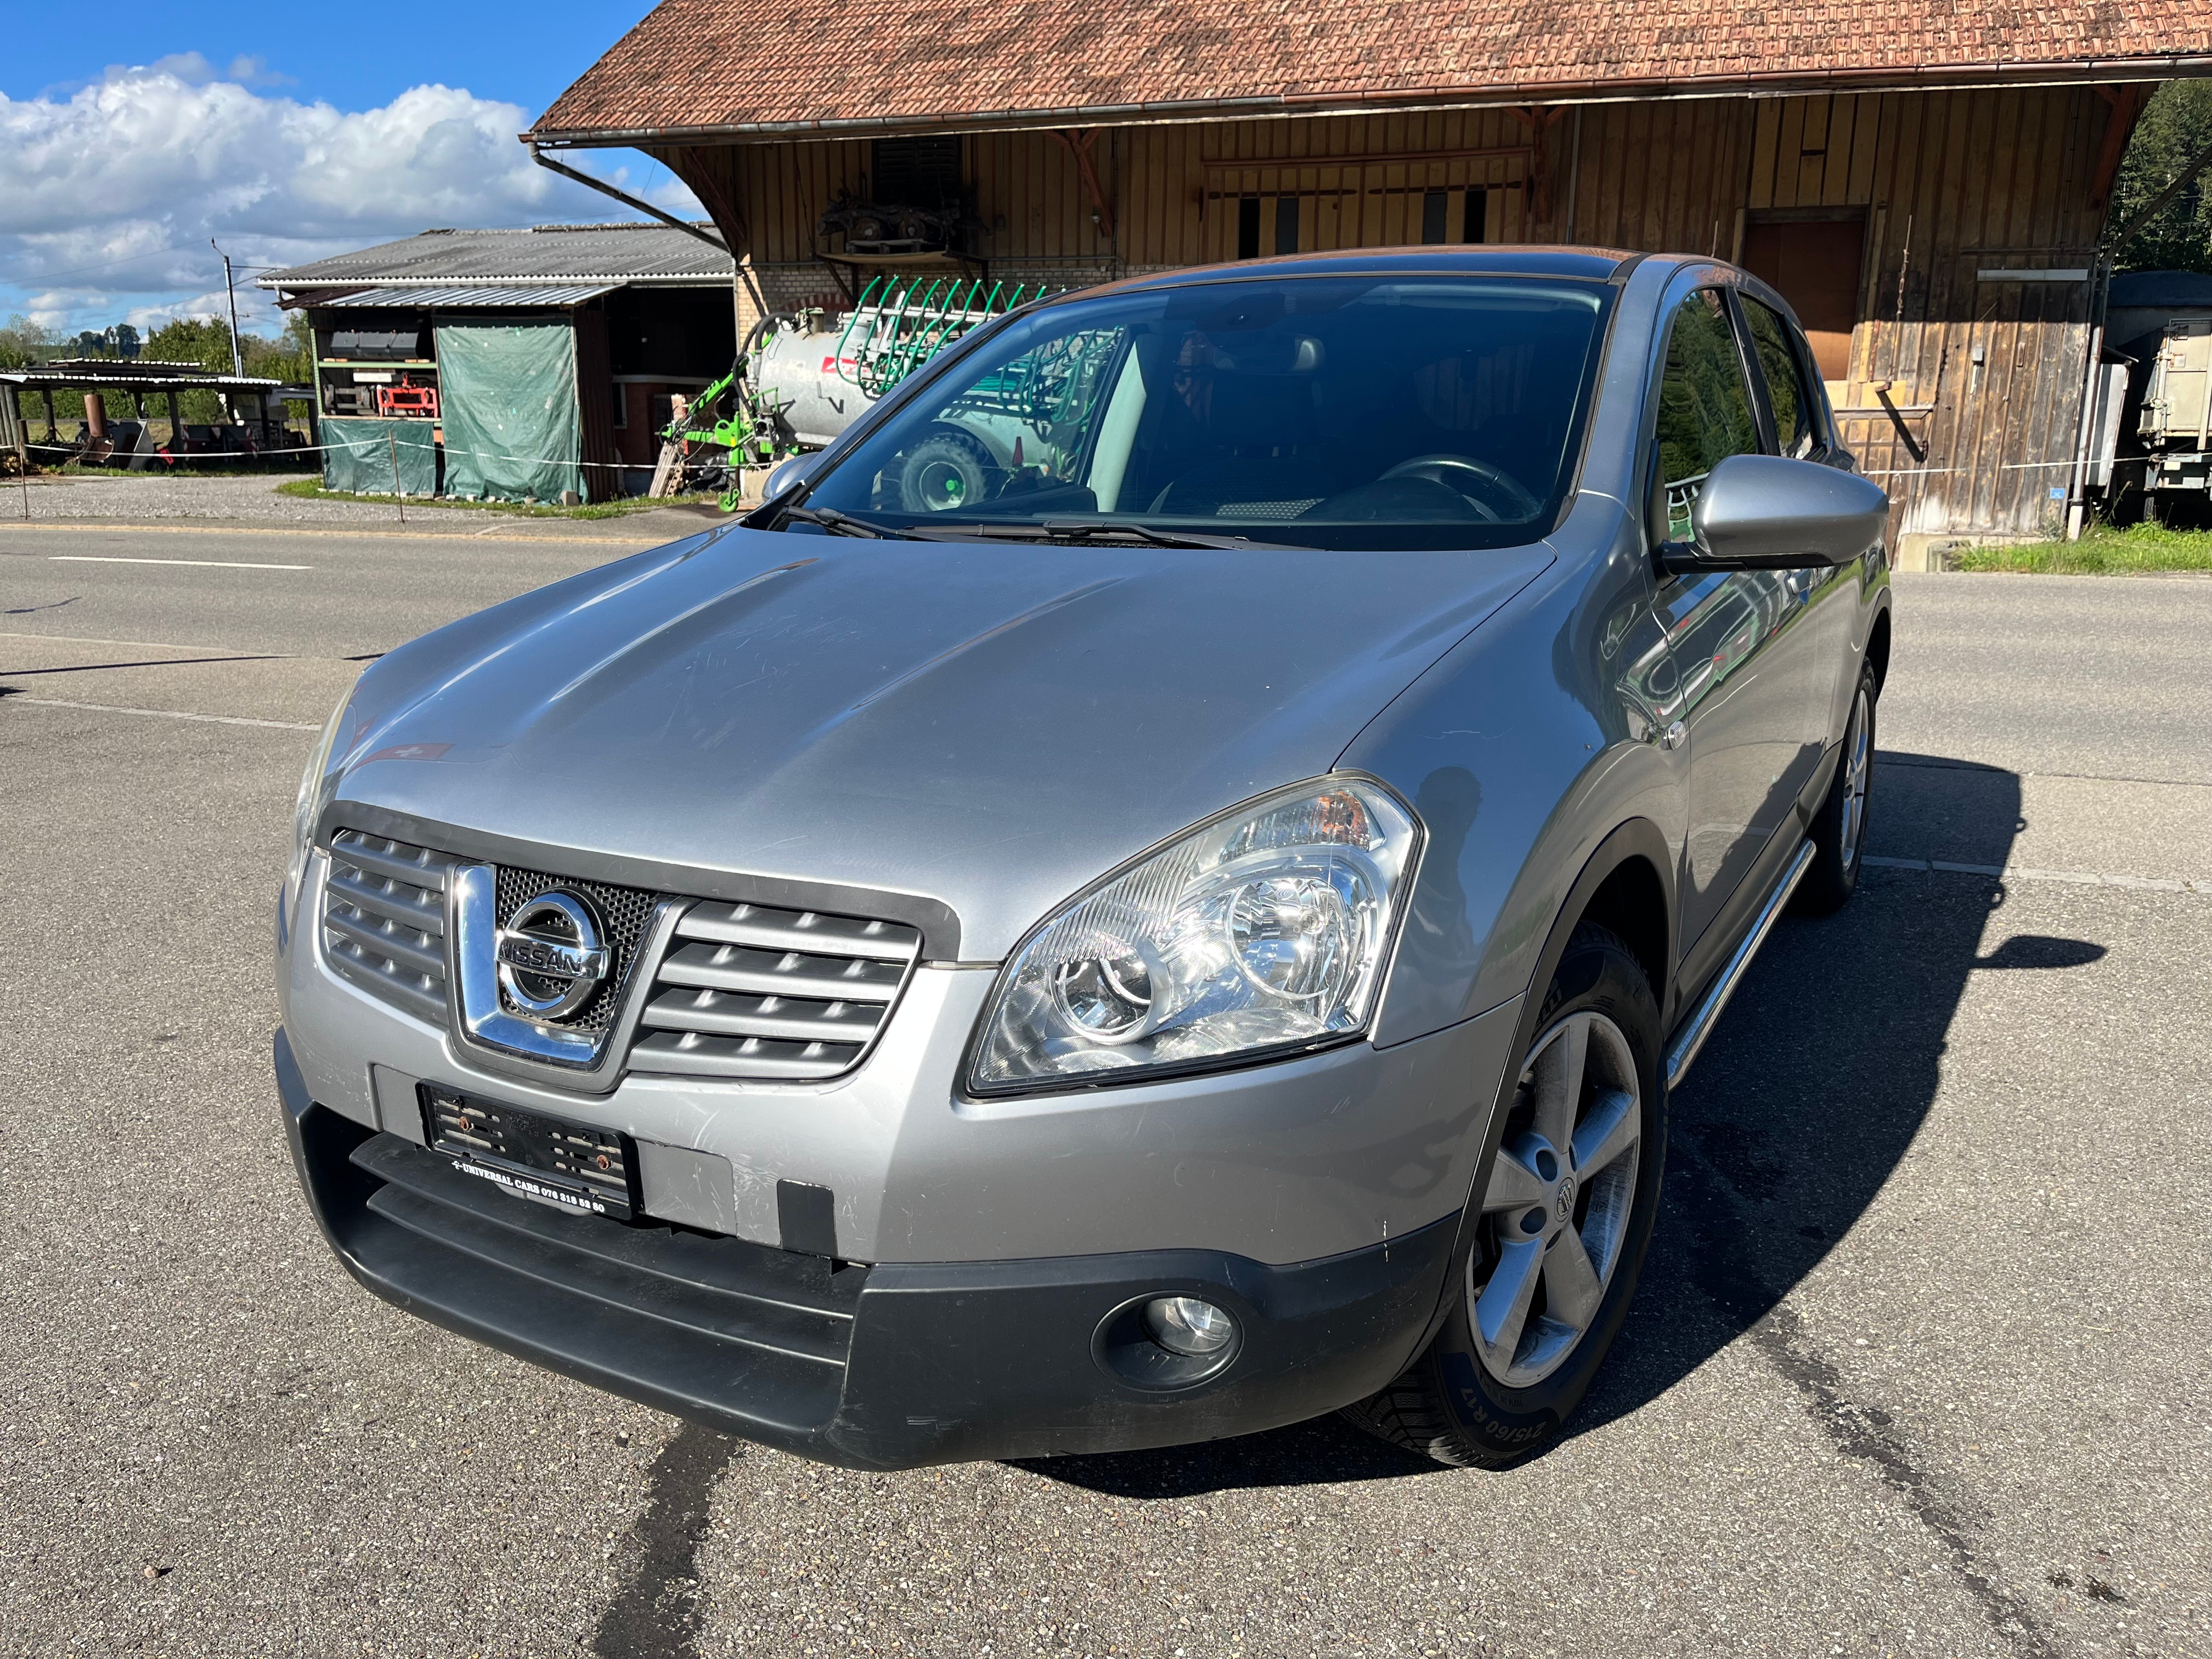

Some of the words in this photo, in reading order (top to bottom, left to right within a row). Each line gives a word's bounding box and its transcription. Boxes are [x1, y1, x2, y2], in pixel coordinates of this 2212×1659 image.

[499, 940, 585, 977] NISSAN
[462, 1163, 514, 1186] UNIVERSAL
[515, 1179, 539, 1194] CARS
[541, 1188, 558, 1199] 076
[1459, 1387, 1488, 1424] R17
[1486, 1420, 1547, 1442] 215/60
